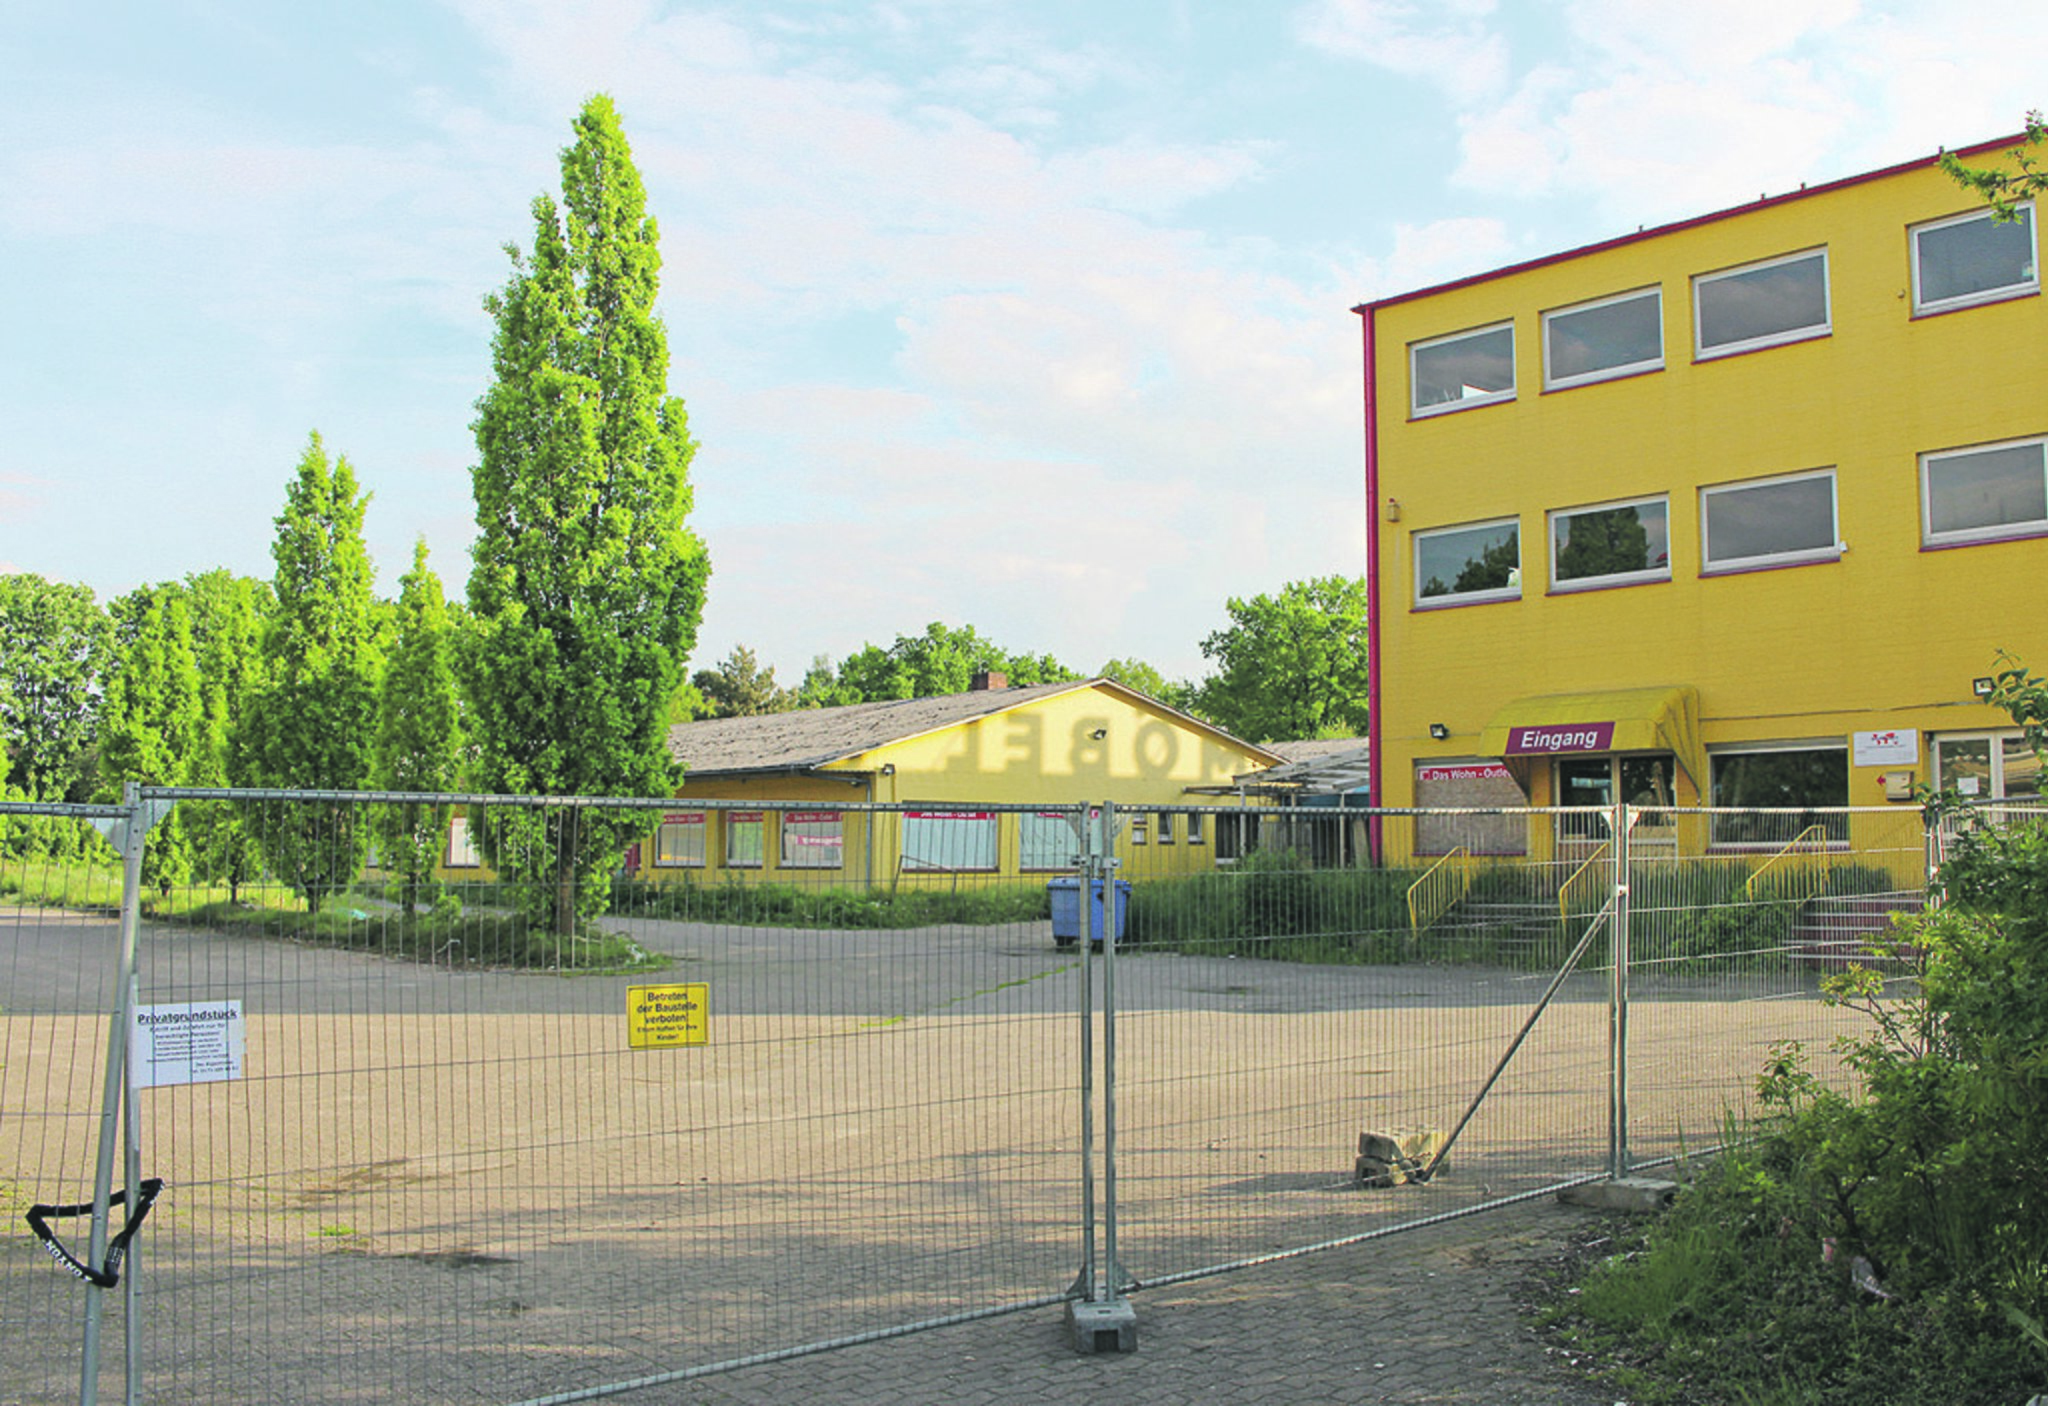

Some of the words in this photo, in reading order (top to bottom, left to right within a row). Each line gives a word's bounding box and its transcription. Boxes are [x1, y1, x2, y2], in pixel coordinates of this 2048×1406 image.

[1521, 730, 1598, 751] Eingang
[1432, 770, 1449, 780] Das
[1450, 769, 1477, 779] Wohn
[647, 991, 688, 1002] Betreten
[636, 1003, 653, 1013] der
